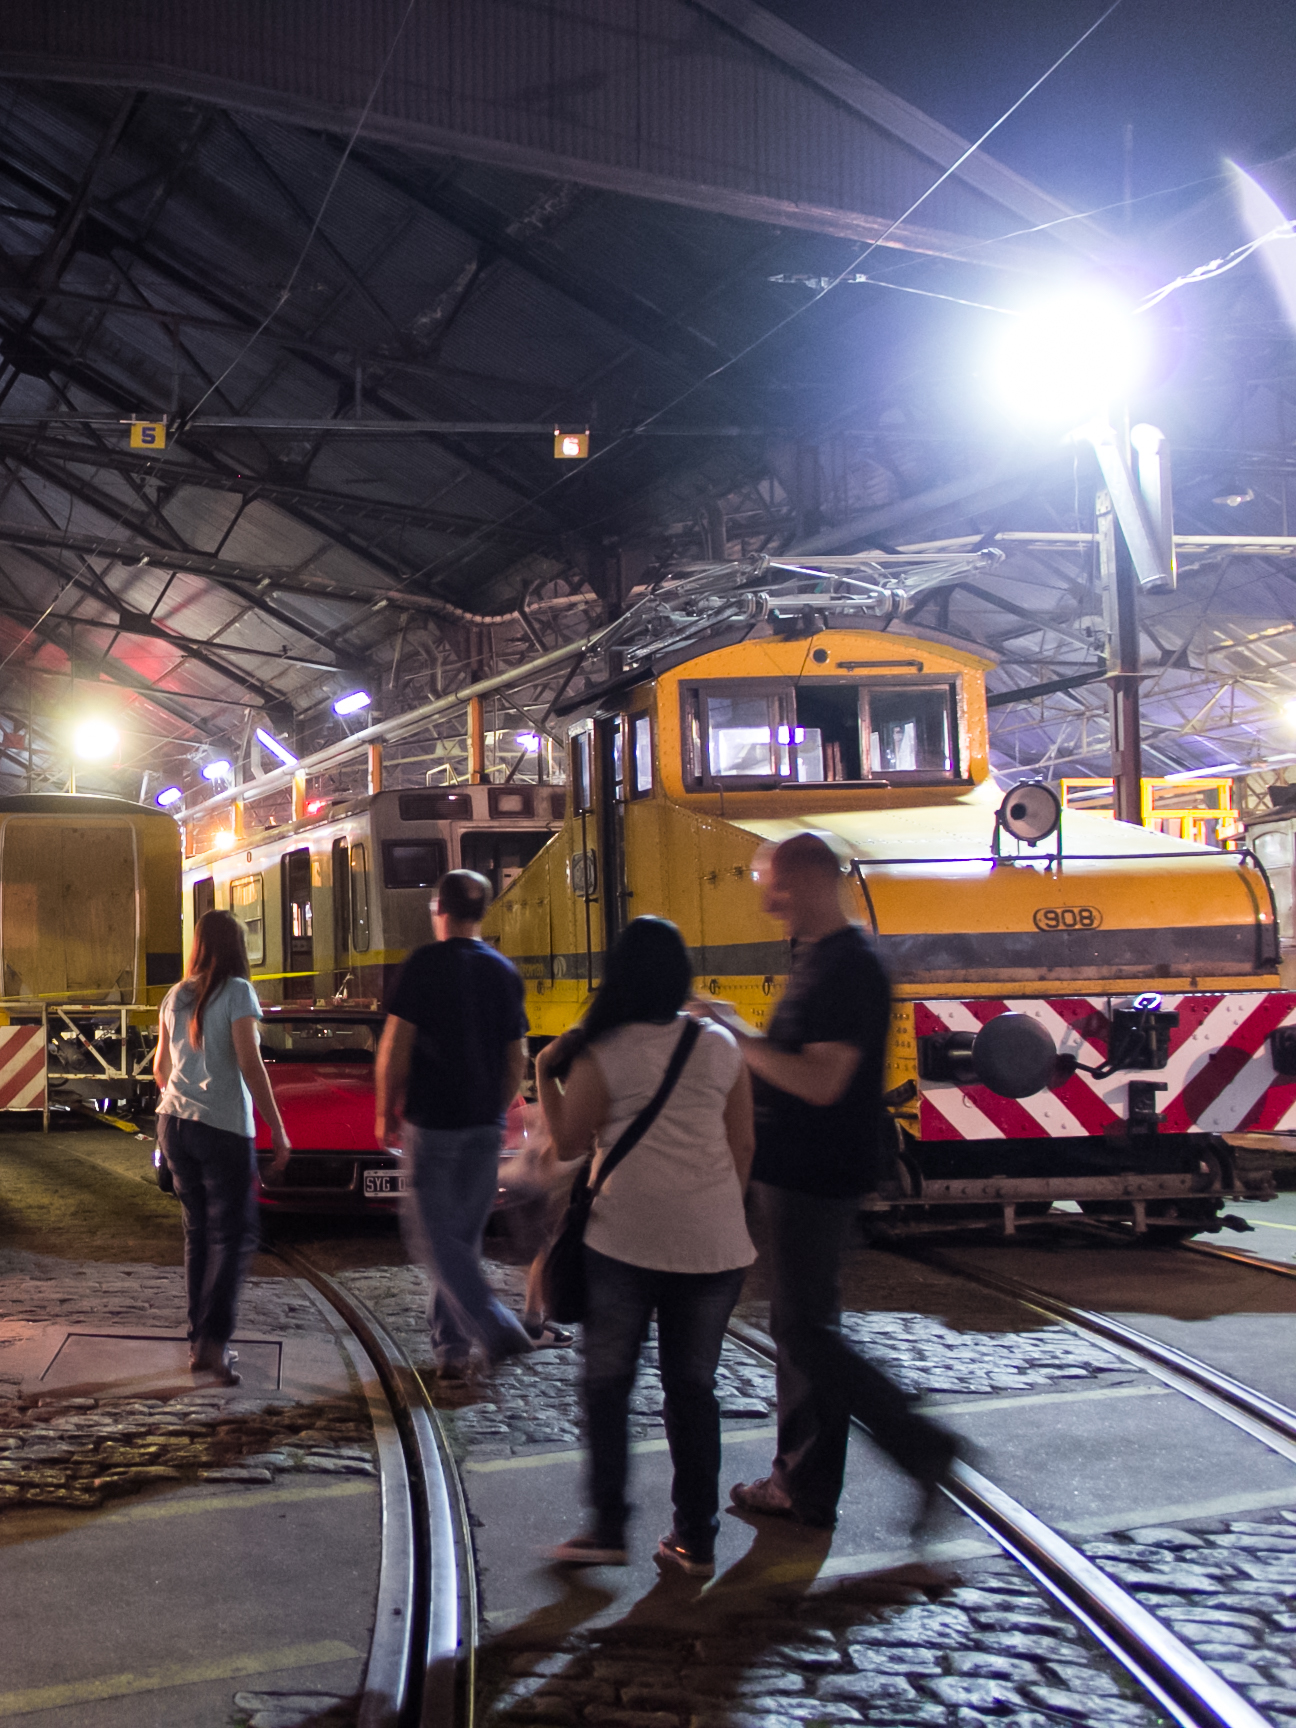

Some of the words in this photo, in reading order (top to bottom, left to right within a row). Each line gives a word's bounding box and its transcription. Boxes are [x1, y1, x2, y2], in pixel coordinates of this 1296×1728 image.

[141, 426, 156, 444] 5
[1044, 908, 1094, 929] 908
[366, 1177, 390, 1191] SYG
